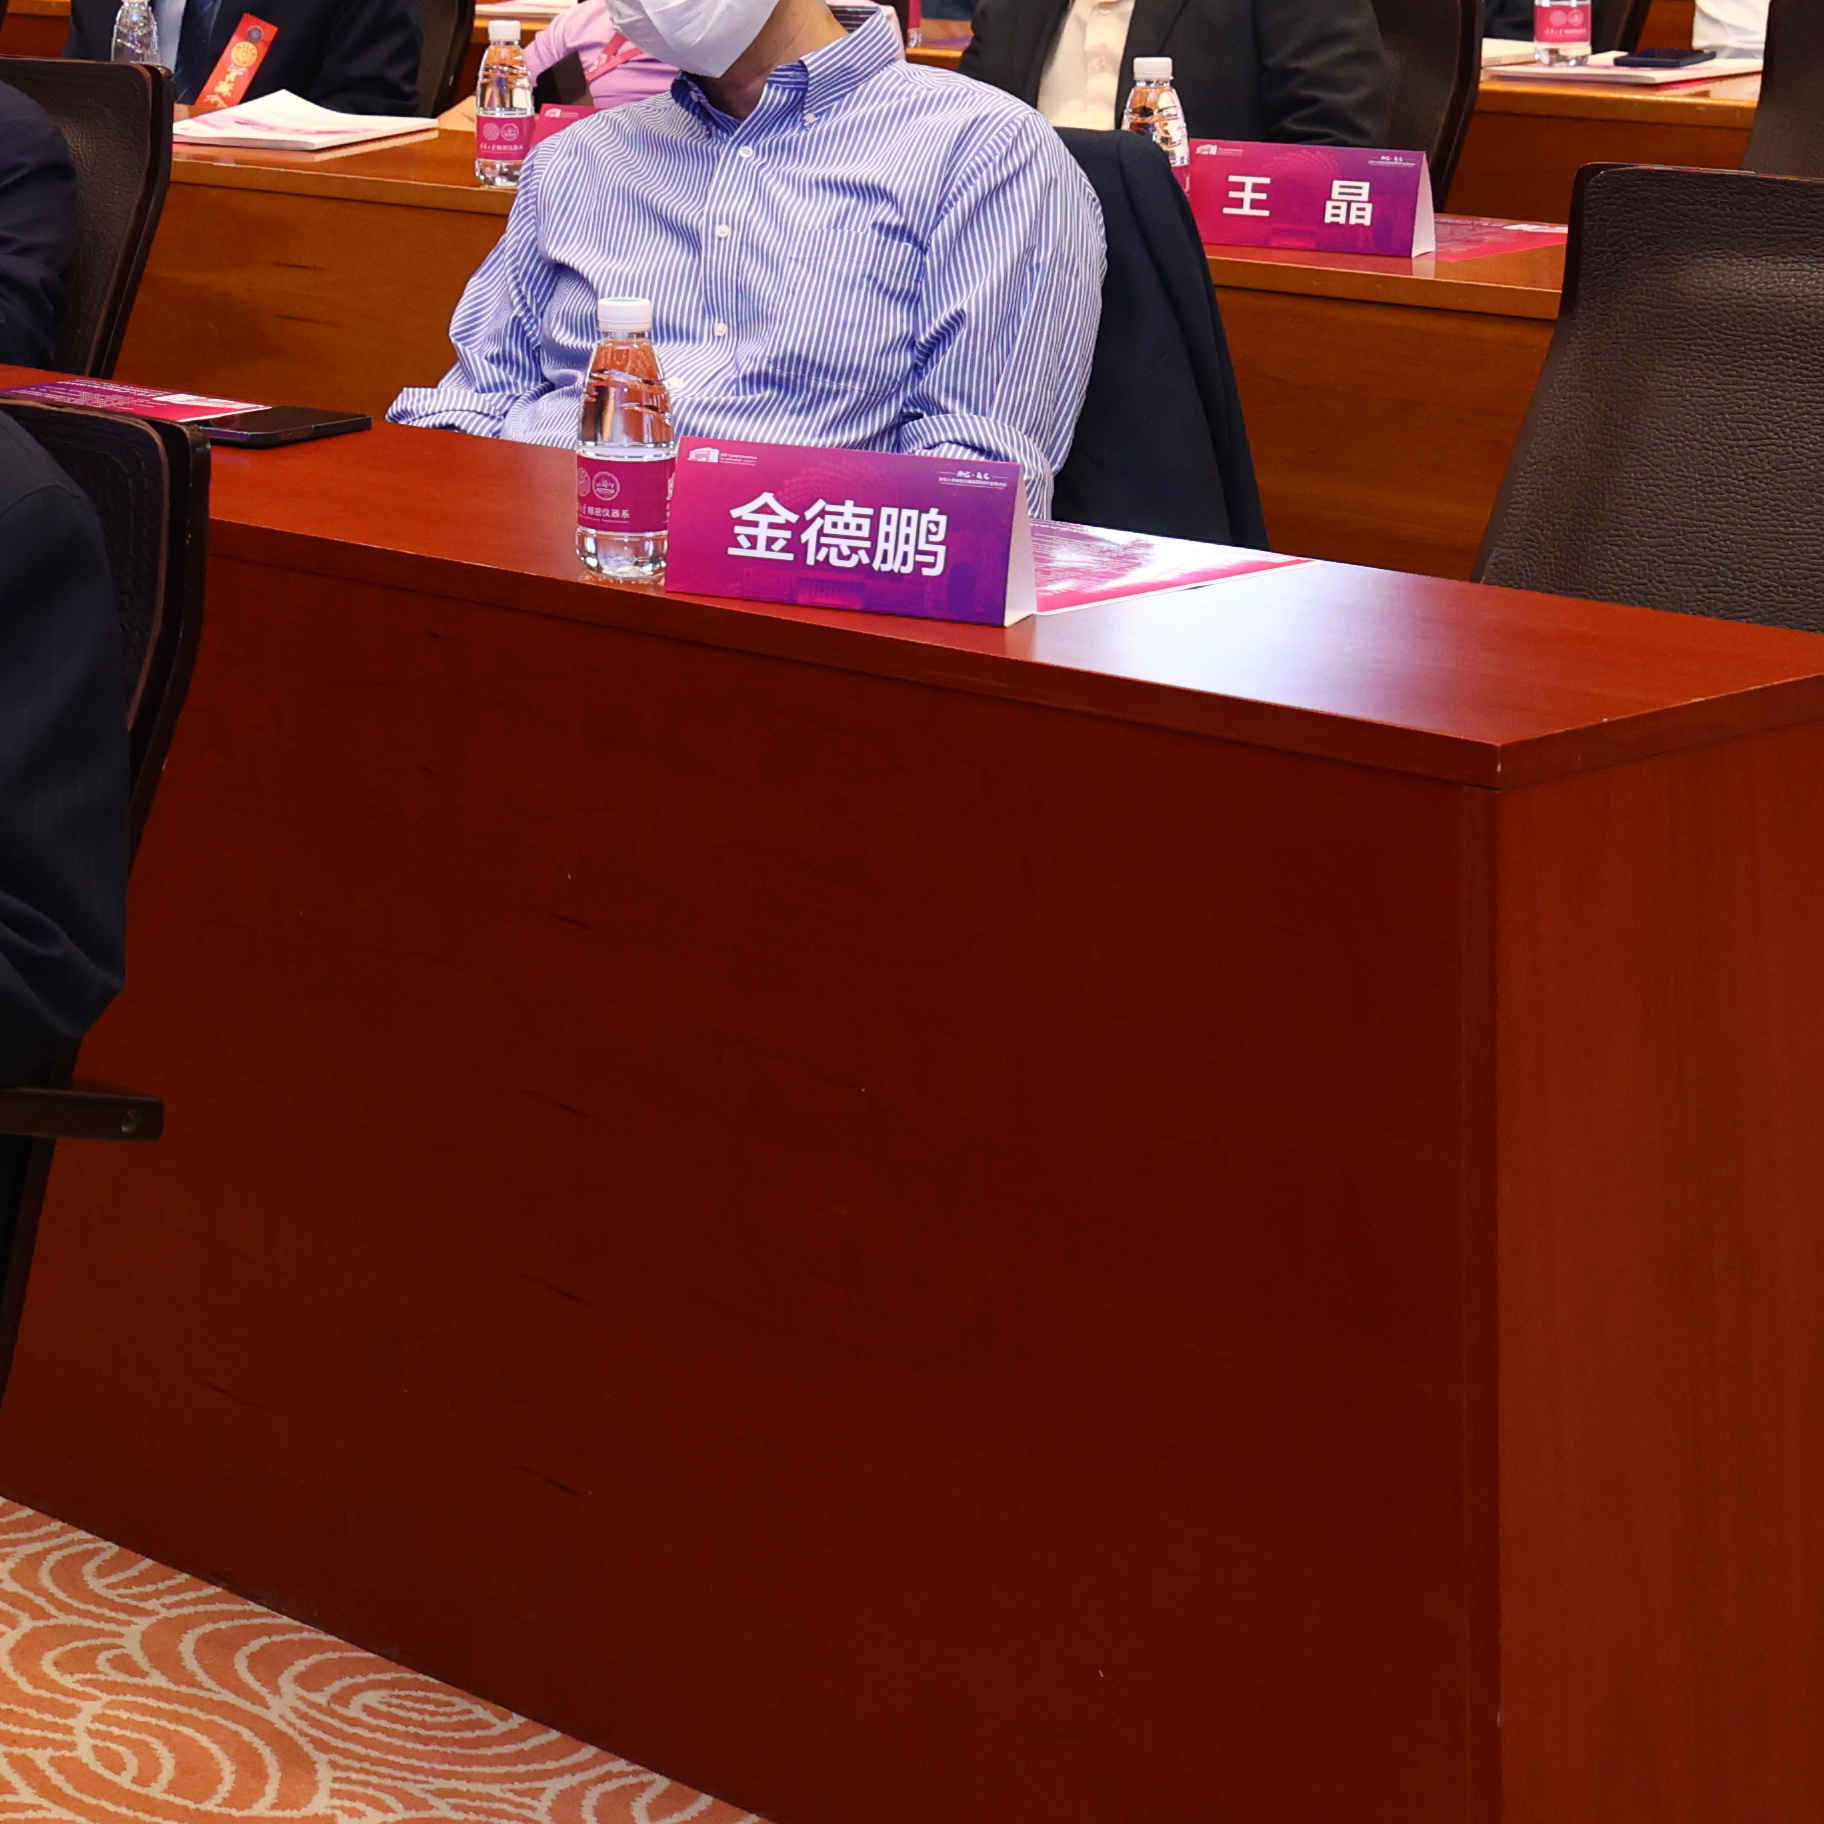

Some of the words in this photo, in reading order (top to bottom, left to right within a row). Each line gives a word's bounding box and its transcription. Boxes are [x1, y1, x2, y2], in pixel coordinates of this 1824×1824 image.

[1222, 174, 1373, 226] 王晶
[727, 491, 948, 578] 金德鹏
